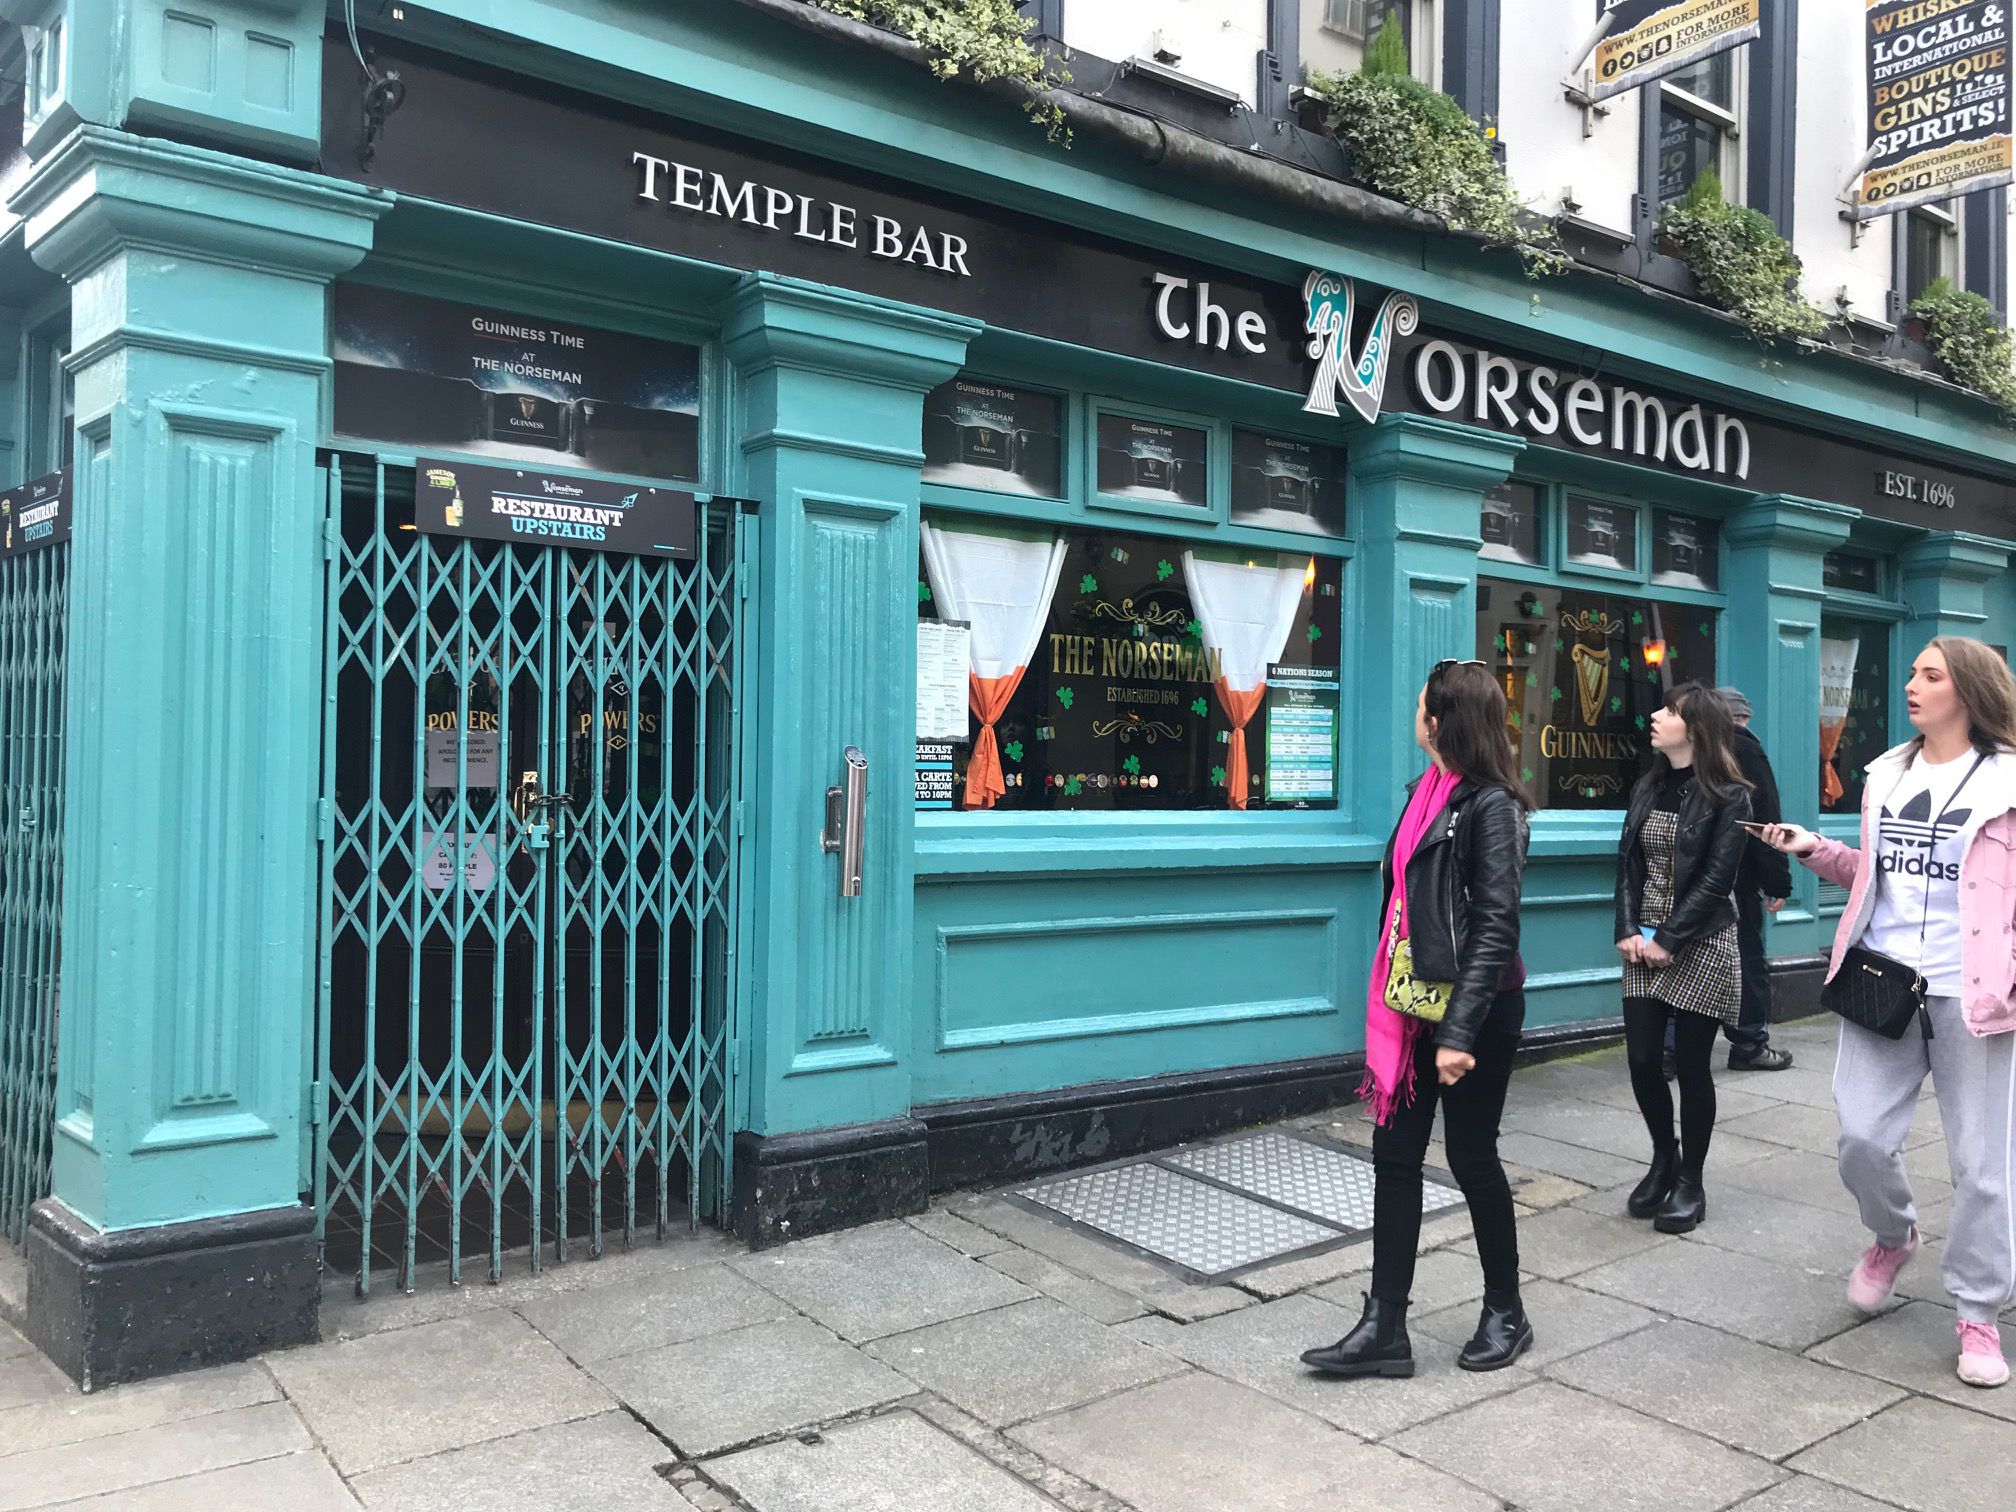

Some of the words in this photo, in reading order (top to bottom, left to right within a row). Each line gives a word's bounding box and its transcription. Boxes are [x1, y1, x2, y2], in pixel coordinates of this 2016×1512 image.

[1676, 24, 1704, 40] FOR
[1707, 2, 1750, 26] MORE
[1676, 13, 1750, 49] INFORMATION
[1872, 0, 1974, 34] WHISK
[1873, 13, 1974, 65] LOCAL
[1981, 5, 2004, 28] &
[1874, 28, 2005, 80] INTERNATIONAL
[1874, 47, 2006, 106] BOUTIQUE
[1874, 87, 1951, 132] GINS
[1952, 98, 1960, 107] &
[1961, 85, 2005, 104] SELECT
[1874, 97, 2006, 158] SPIRITS!
[1935, 163, 1961, 178] FOR
[1964, 152, 2004, 170] MORE
[633, 151, 857, 250] TEMPLE
[872, 213, 972, 278] BAR
[1153, 271, 1267, 354] The
[472, 318, 546, 342] GUINNESS
[550, 331, 584, 349] TIME
[472, 356, 499, 371] THE
[504, 361, 582, 385] NORSEMAN
[521, 353, 536, 362] AT
[956, 406, 971, 415] THE
[972, 408, 1014, 423] NORSEMAN
[1885, 470, 1917, 500] EST.
[1922, 479, 1955, 509] 1696
[19, 500, 59, 528] RESTAURANT
[491, 496, 623, 527] RESTAURANT
[511, 516, 606, 542] UPSTAIRS
[1050, 633, 1095, 676] THE
[1101, 637, 1223, 684] NORSEMAN
[1277, 667, 1307, 677] NATIONS
[1308, 669, 1333, 678] SEASON
[1107, 686, 1159, 704] ESTABLISHED
[1161, 690, 1179, 706] 1696
[581, 710, 656, 734] PWERS
[1541, 724, 1637, 760] GUINNESS
[921, 772, 952, 782] CARTE
[929, 782, 952, 790] FROM
[932, 791, 952, 799] 10PM
[1879, 850, 1960, 882] didas
